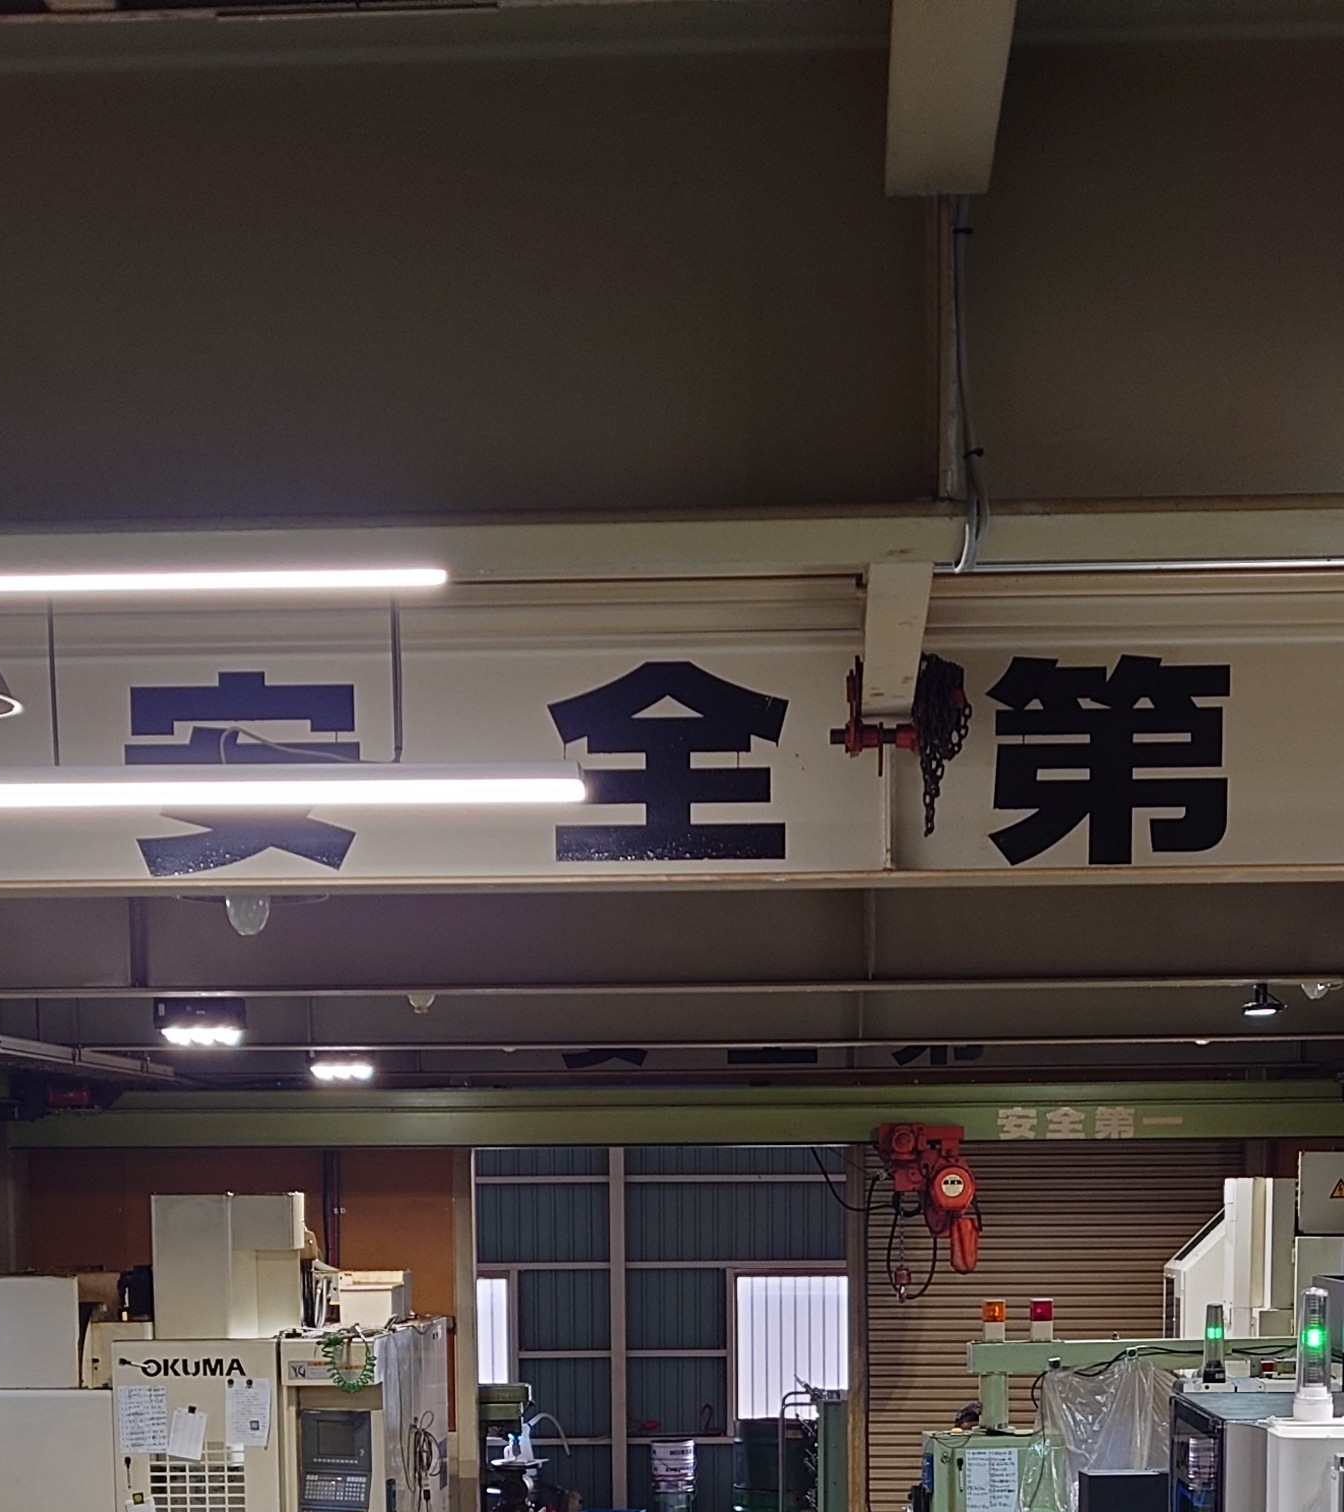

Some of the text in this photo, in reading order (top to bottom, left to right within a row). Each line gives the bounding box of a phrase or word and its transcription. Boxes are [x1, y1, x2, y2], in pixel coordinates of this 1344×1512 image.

[996, 1106, 1184, 1141] 安全第一
[141, 1357, 246, 1378] OKUMA
